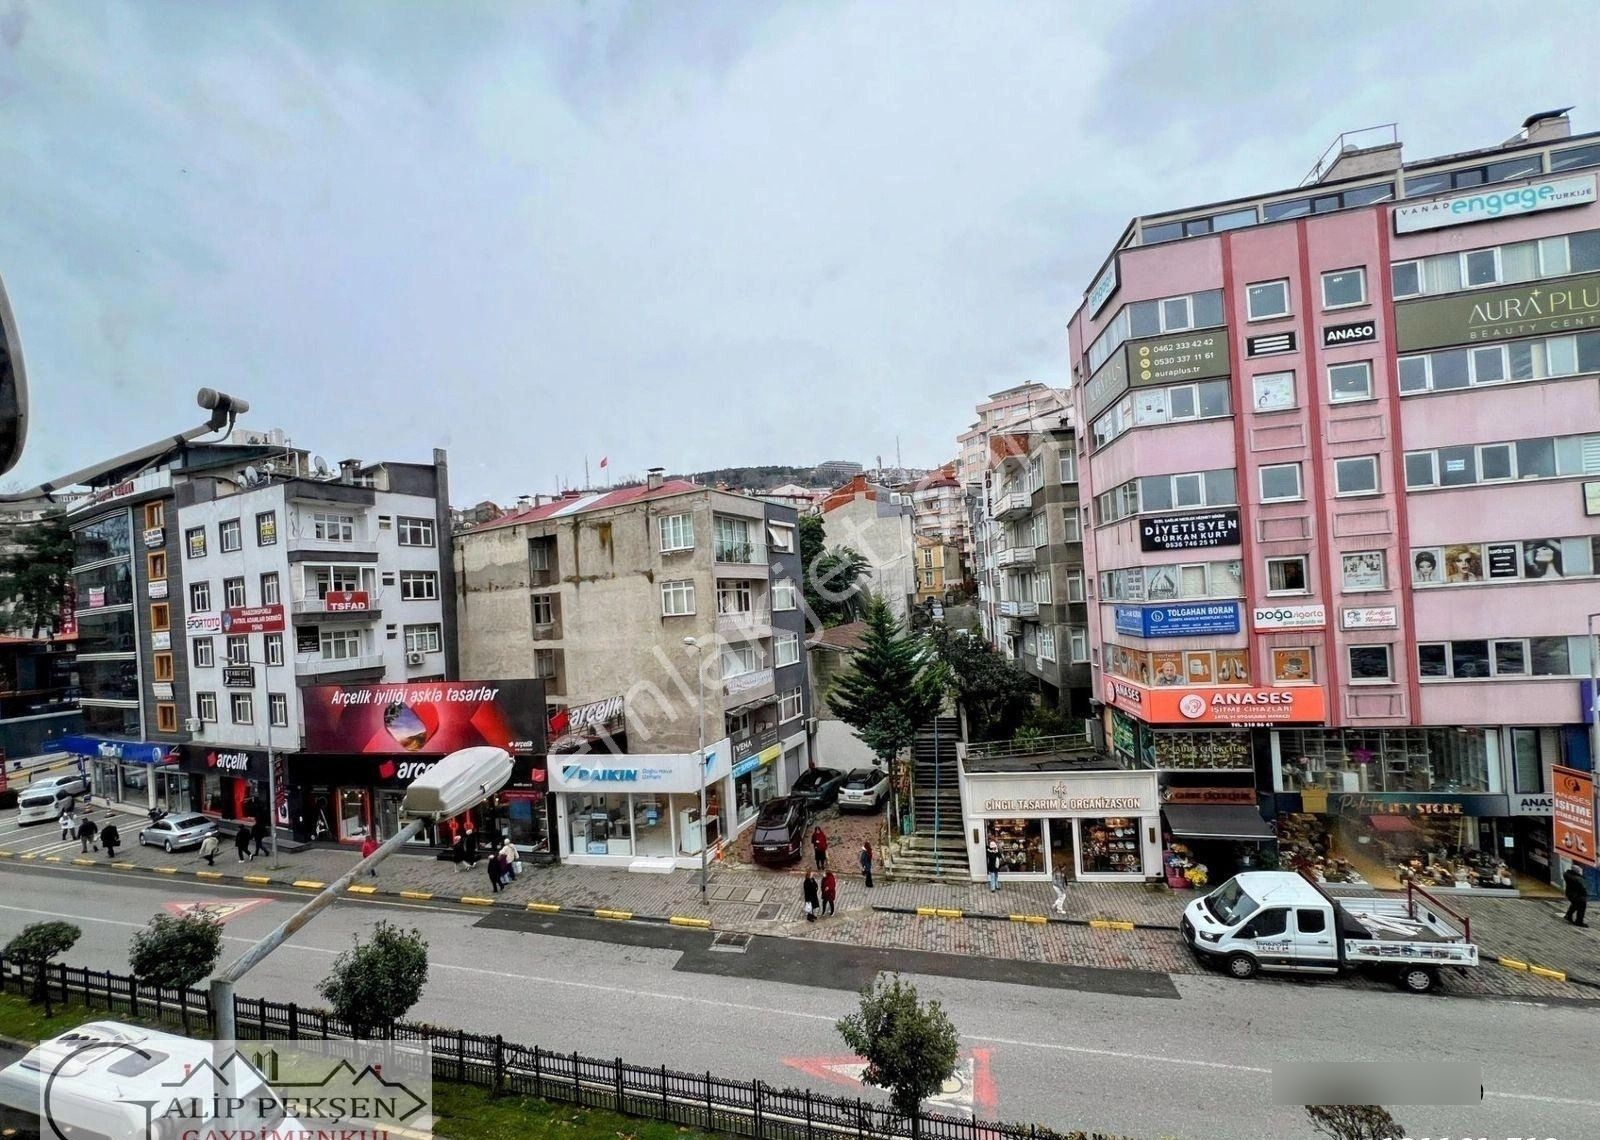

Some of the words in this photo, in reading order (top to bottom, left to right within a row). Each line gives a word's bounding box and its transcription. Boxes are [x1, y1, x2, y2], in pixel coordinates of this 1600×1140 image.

[1401, 202, 1450, 216] VANAD
[1451, 185, 1554, 215] engage
[1468, 295, 1543, 324] AURA
[1327, 326, 1373, 342] ANASO
[1470, 323, 1537, 339] BEAUTY
[1153, 344, 1174, 354] 0462
[1175, 342, 1190, 351] 333
[1191, 340, 1202, 348] 42
[1203, 338, 1214, 346] 42
[1153, 357, 1175, 367] 0530
[1176, 355, 1191, 363] 337
[1194, 353, 1202, 361] 11
[1204, 351, 1214, 359] 61
[1154, 365, 1201, 379] auraplus.tr
[1145, 520, 1237, 536] DİYETİSYEN
[1154, 532, 1198, 543] GÜRKAN
[1200, 530, 1229, 539] KURT
[330, 602, 366, 611] TSFAD
[1167, 607, 1207, 617] TOLGAHAN
[1207, 606, 1234, 615] BORAN
[331, 690, 371, 707] Arçelik
[374, 688, 407, 705] iyiliği
[410, 688, 442, 704] aşkla
[446, 686, 499, 702] tasarlar
[1211, 691, 1294, 705] ANASES
[216, 752, 249, 773] arçelik
[578, 769, 638, 782] DAIKIN
[1019, 798, 1058, 810] TASARIM
[1060, 799, 1067, 809] &
[1520, 798, 1553, 807] ANAS
[1555, 791, 1592, 806] ANASES
[1416, 802, 1464, 815] STORE
